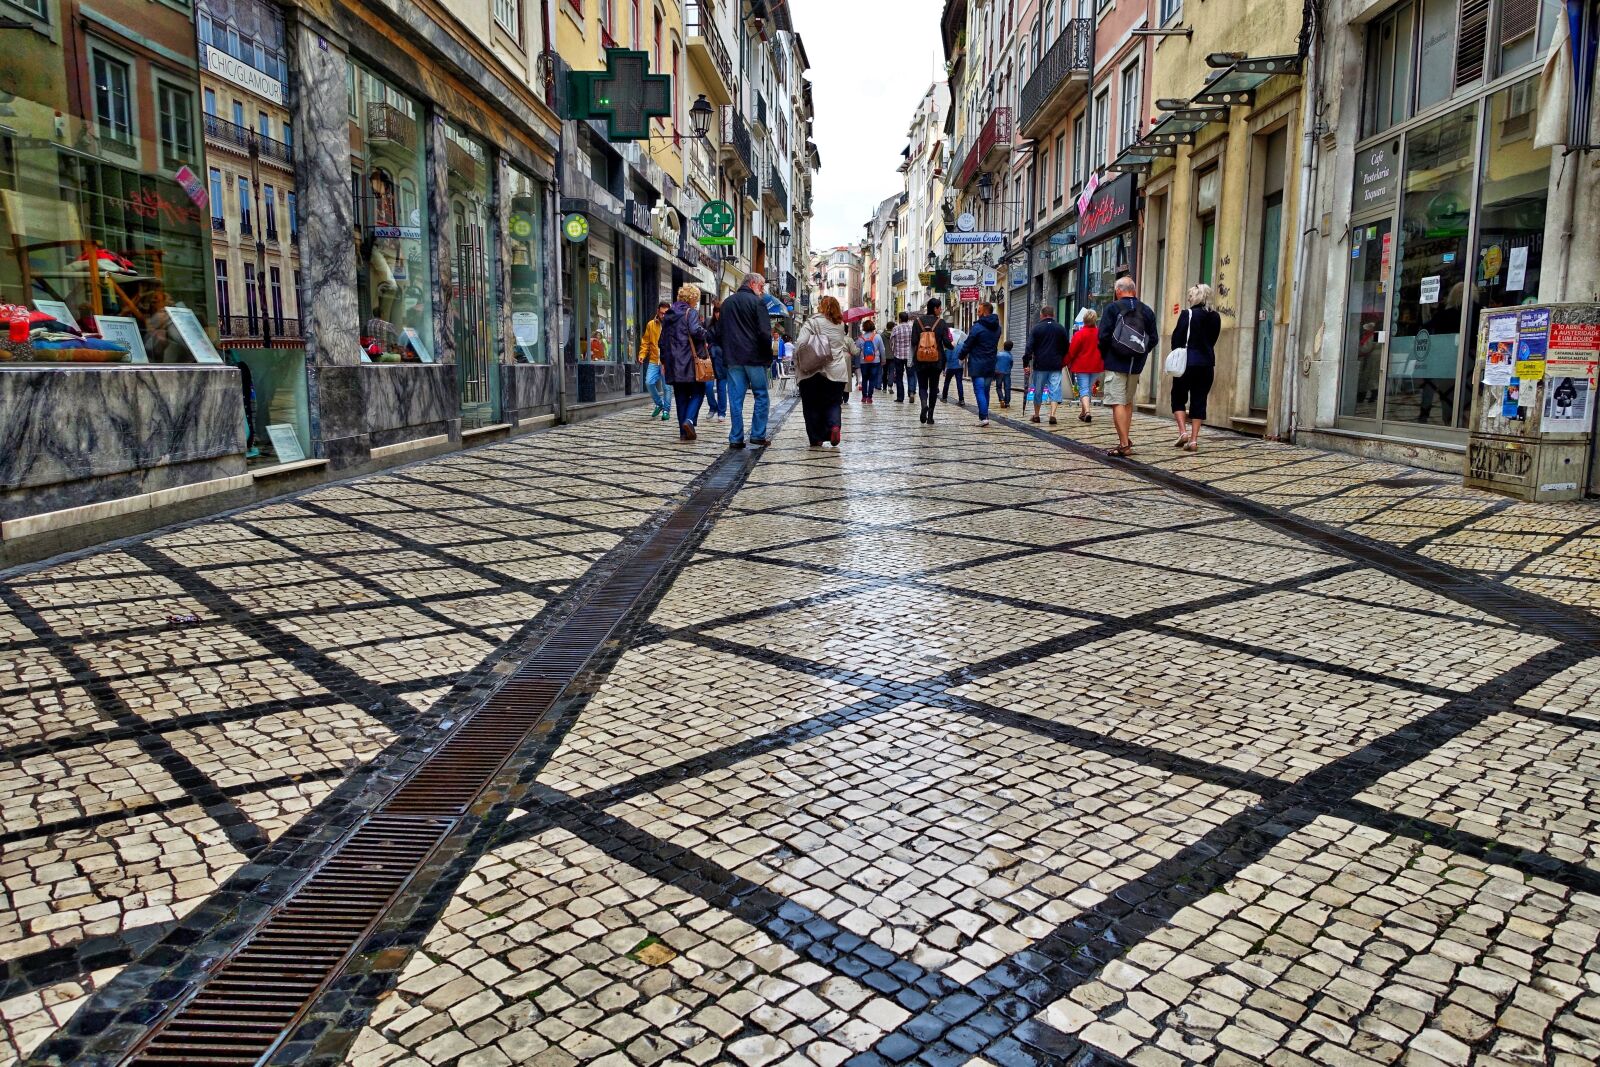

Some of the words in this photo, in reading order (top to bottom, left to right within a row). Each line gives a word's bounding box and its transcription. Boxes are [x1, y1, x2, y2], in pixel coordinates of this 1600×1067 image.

[1371, 150, 1385, 166] Café
[1363, 166, 1390, 185] Pastelaria
[982, 232, 1001, 242] Costa
